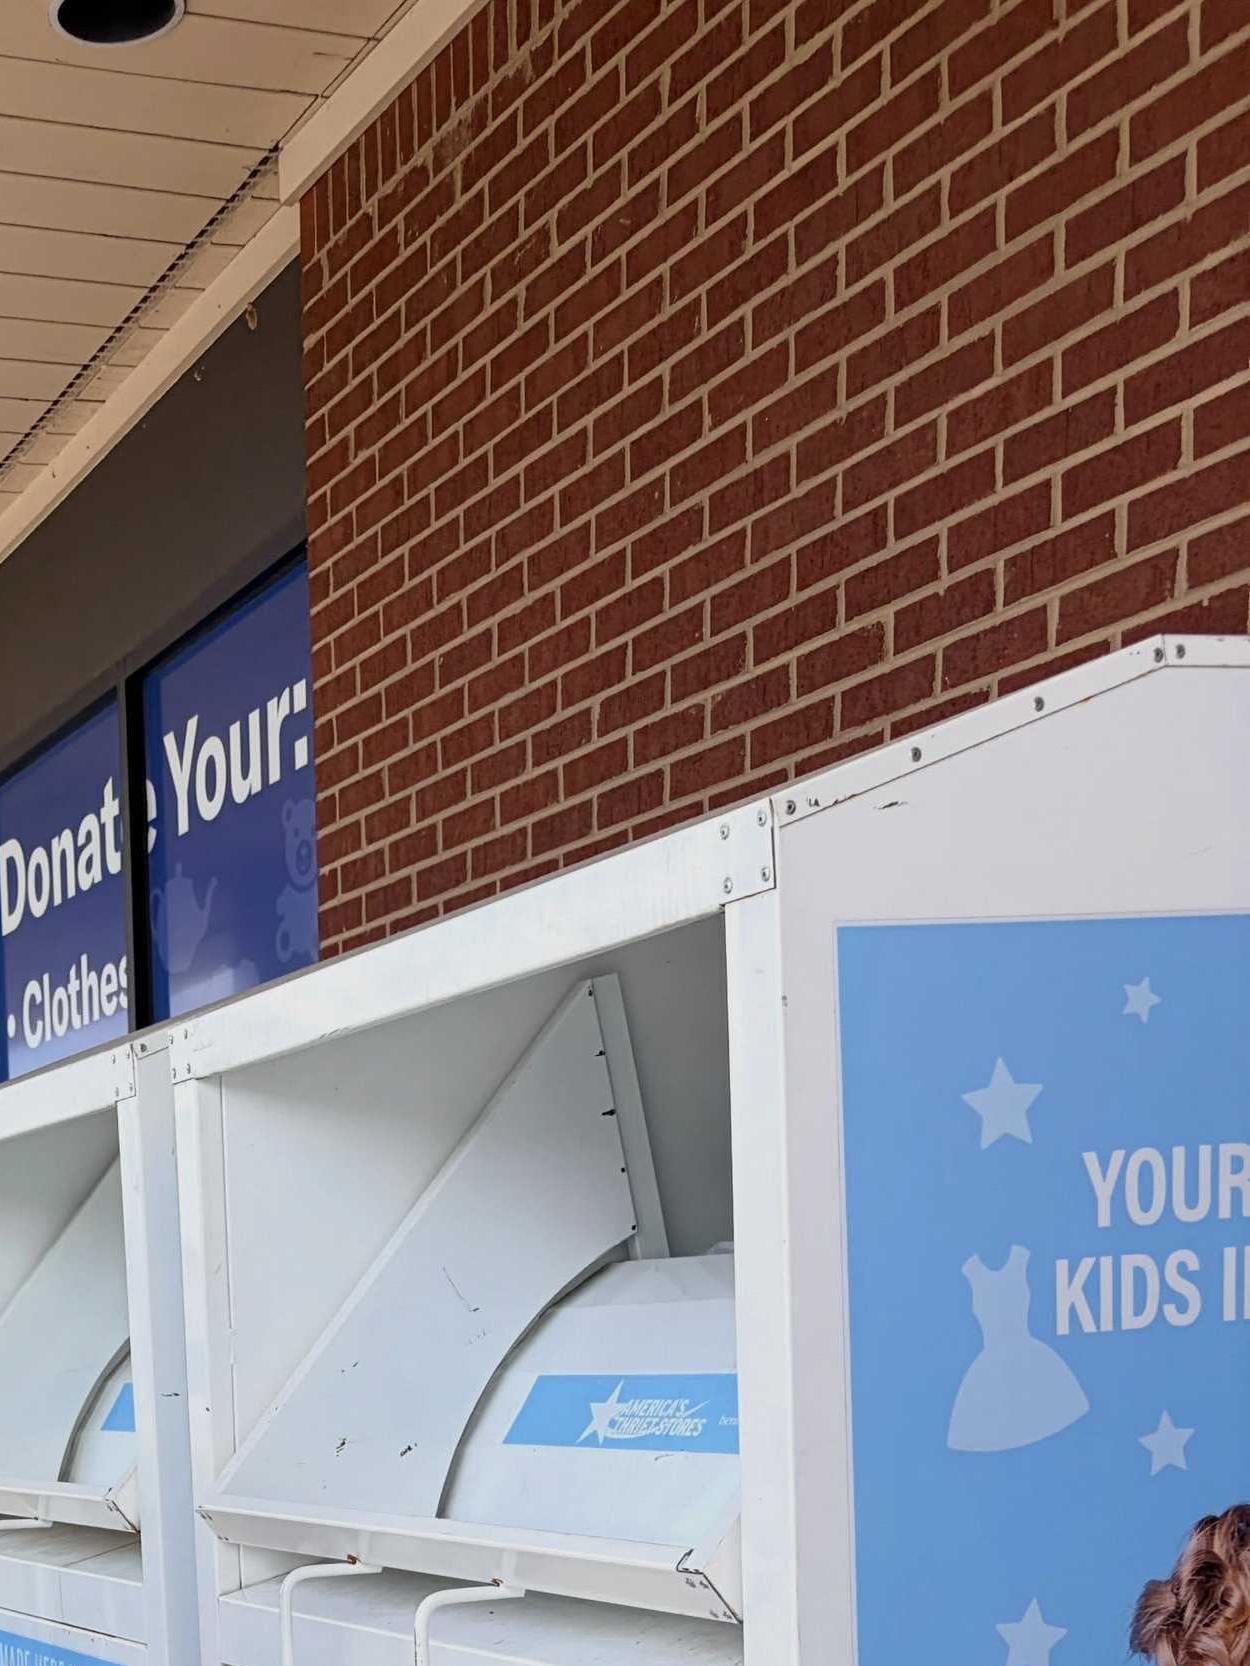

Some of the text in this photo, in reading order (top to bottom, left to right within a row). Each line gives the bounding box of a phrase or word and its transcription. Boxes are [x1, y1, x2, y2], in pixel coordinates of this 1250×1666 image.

[163, 678, 309, 837] Your:
[1082, 1142, 1250, 1228] YOUR
[1055, 1248, 1202, 1336] KIDS
[622, 1398, 689, 1417] AMERICA'S
